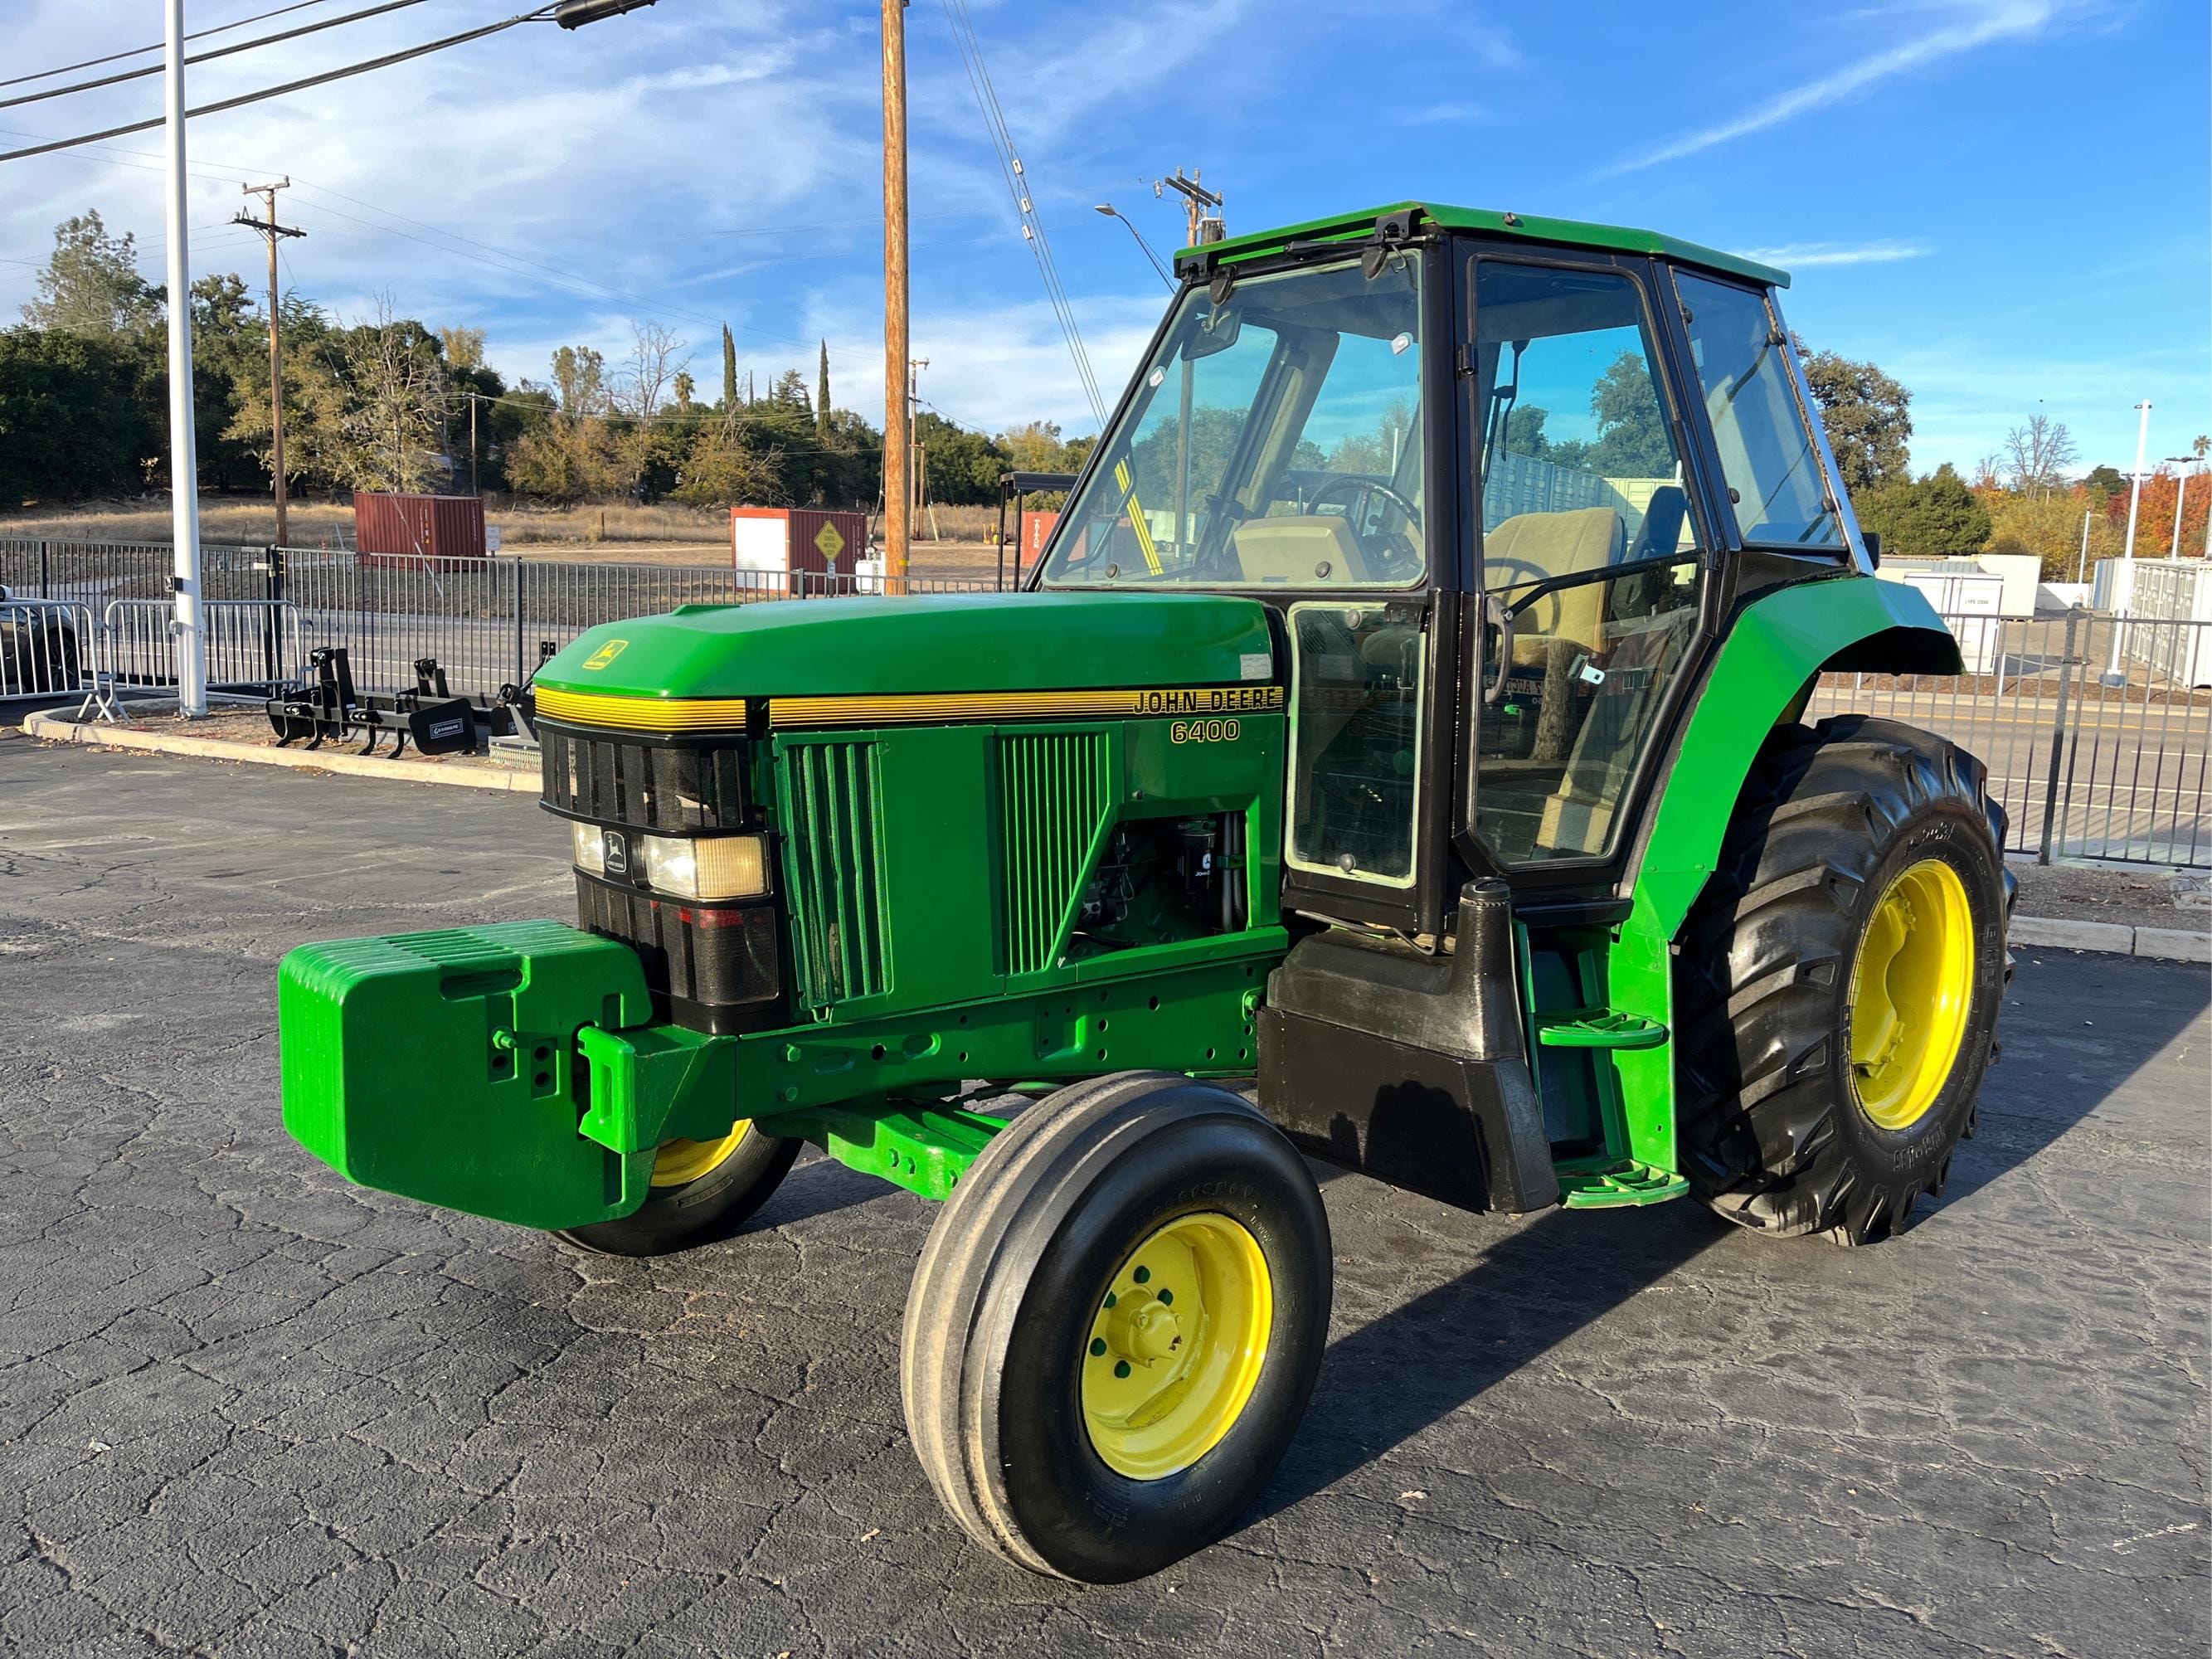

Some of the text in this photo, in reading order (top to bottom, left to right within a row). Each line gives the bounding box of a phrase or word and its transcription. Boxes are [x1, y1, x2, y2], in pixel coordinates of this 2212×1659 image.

[1133, 688, 1276, 714] JOHN DEERE
[1171, 719, 1240, 744] 6400
